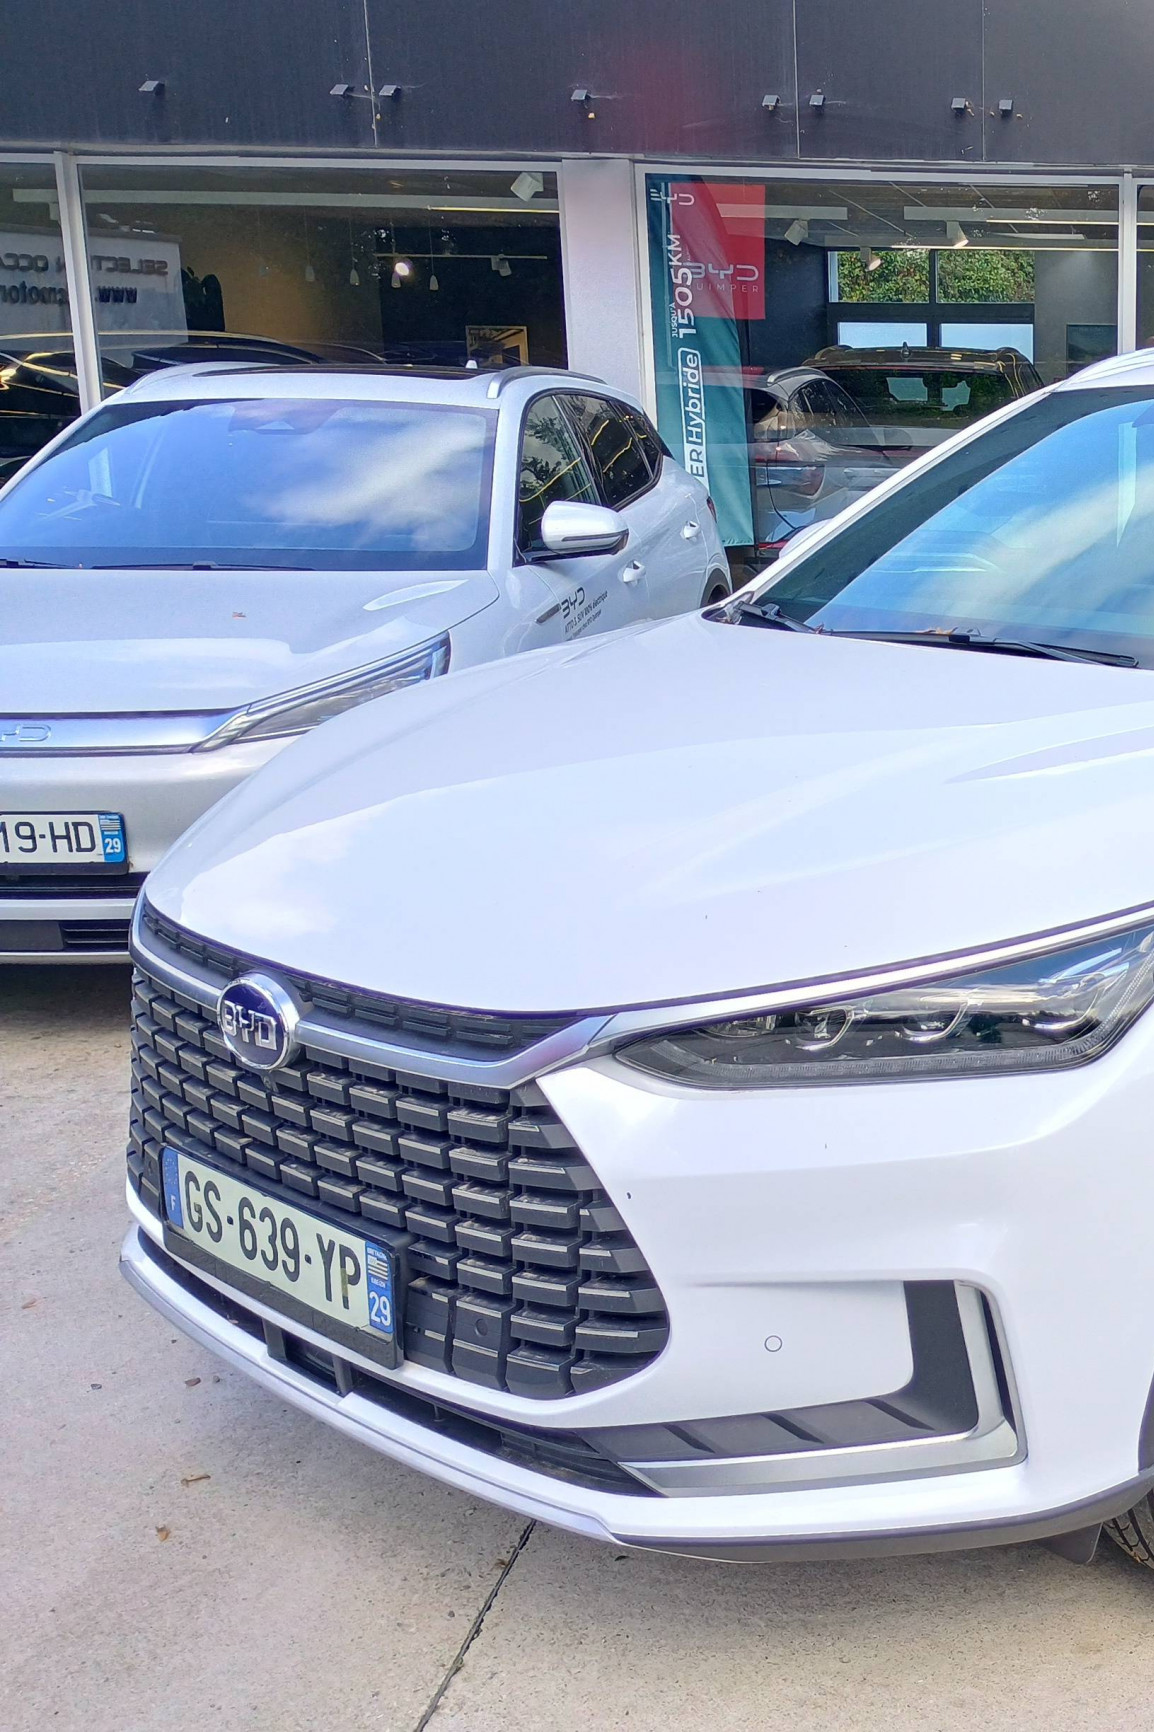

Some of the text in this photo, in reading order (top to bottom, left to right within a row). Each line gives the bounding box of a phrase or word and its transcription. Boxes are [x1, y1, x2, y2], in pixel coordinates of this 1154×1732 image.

[683, 262, 759, 281] BYD
[697, 283, 759, 293] UIMPER
[682, 353, 704, 478] ER Hybride
[561, 587, 586, 619] BYD
[104, 837, 121, 854] 29
[223, 1000, 278, 1051] BYD
[170, 1194, 176, 1211] F
[184, 1170, 361, 1310] GS-639-YP
[369, 1291, 391, 1327] 29
